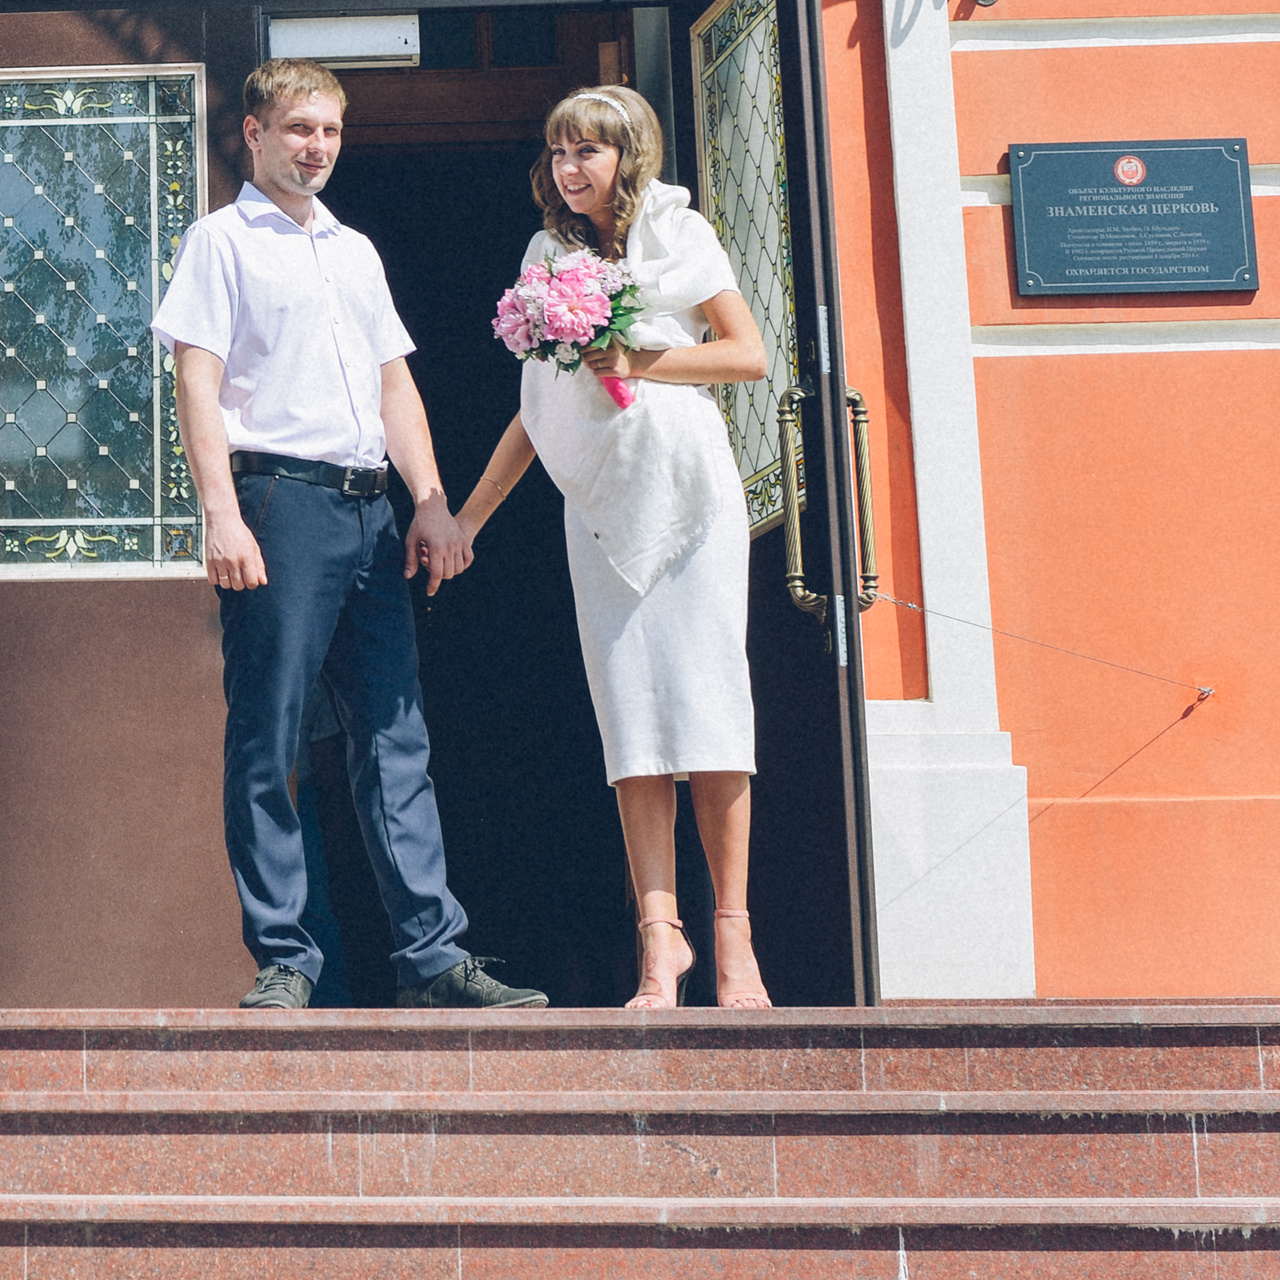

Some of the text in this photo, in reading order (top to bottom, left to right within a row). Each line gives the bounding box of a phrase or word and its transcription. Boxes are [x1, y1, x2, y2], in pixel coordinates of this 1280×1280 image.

[1047, 203, 1219, 217] ЗНАМЕНСКАЯ ЦЕРКОВЬ
[1066, 266, 1209, 276] ОХРАНЯЕТСЯ ГОСУДАРСТВОМ
